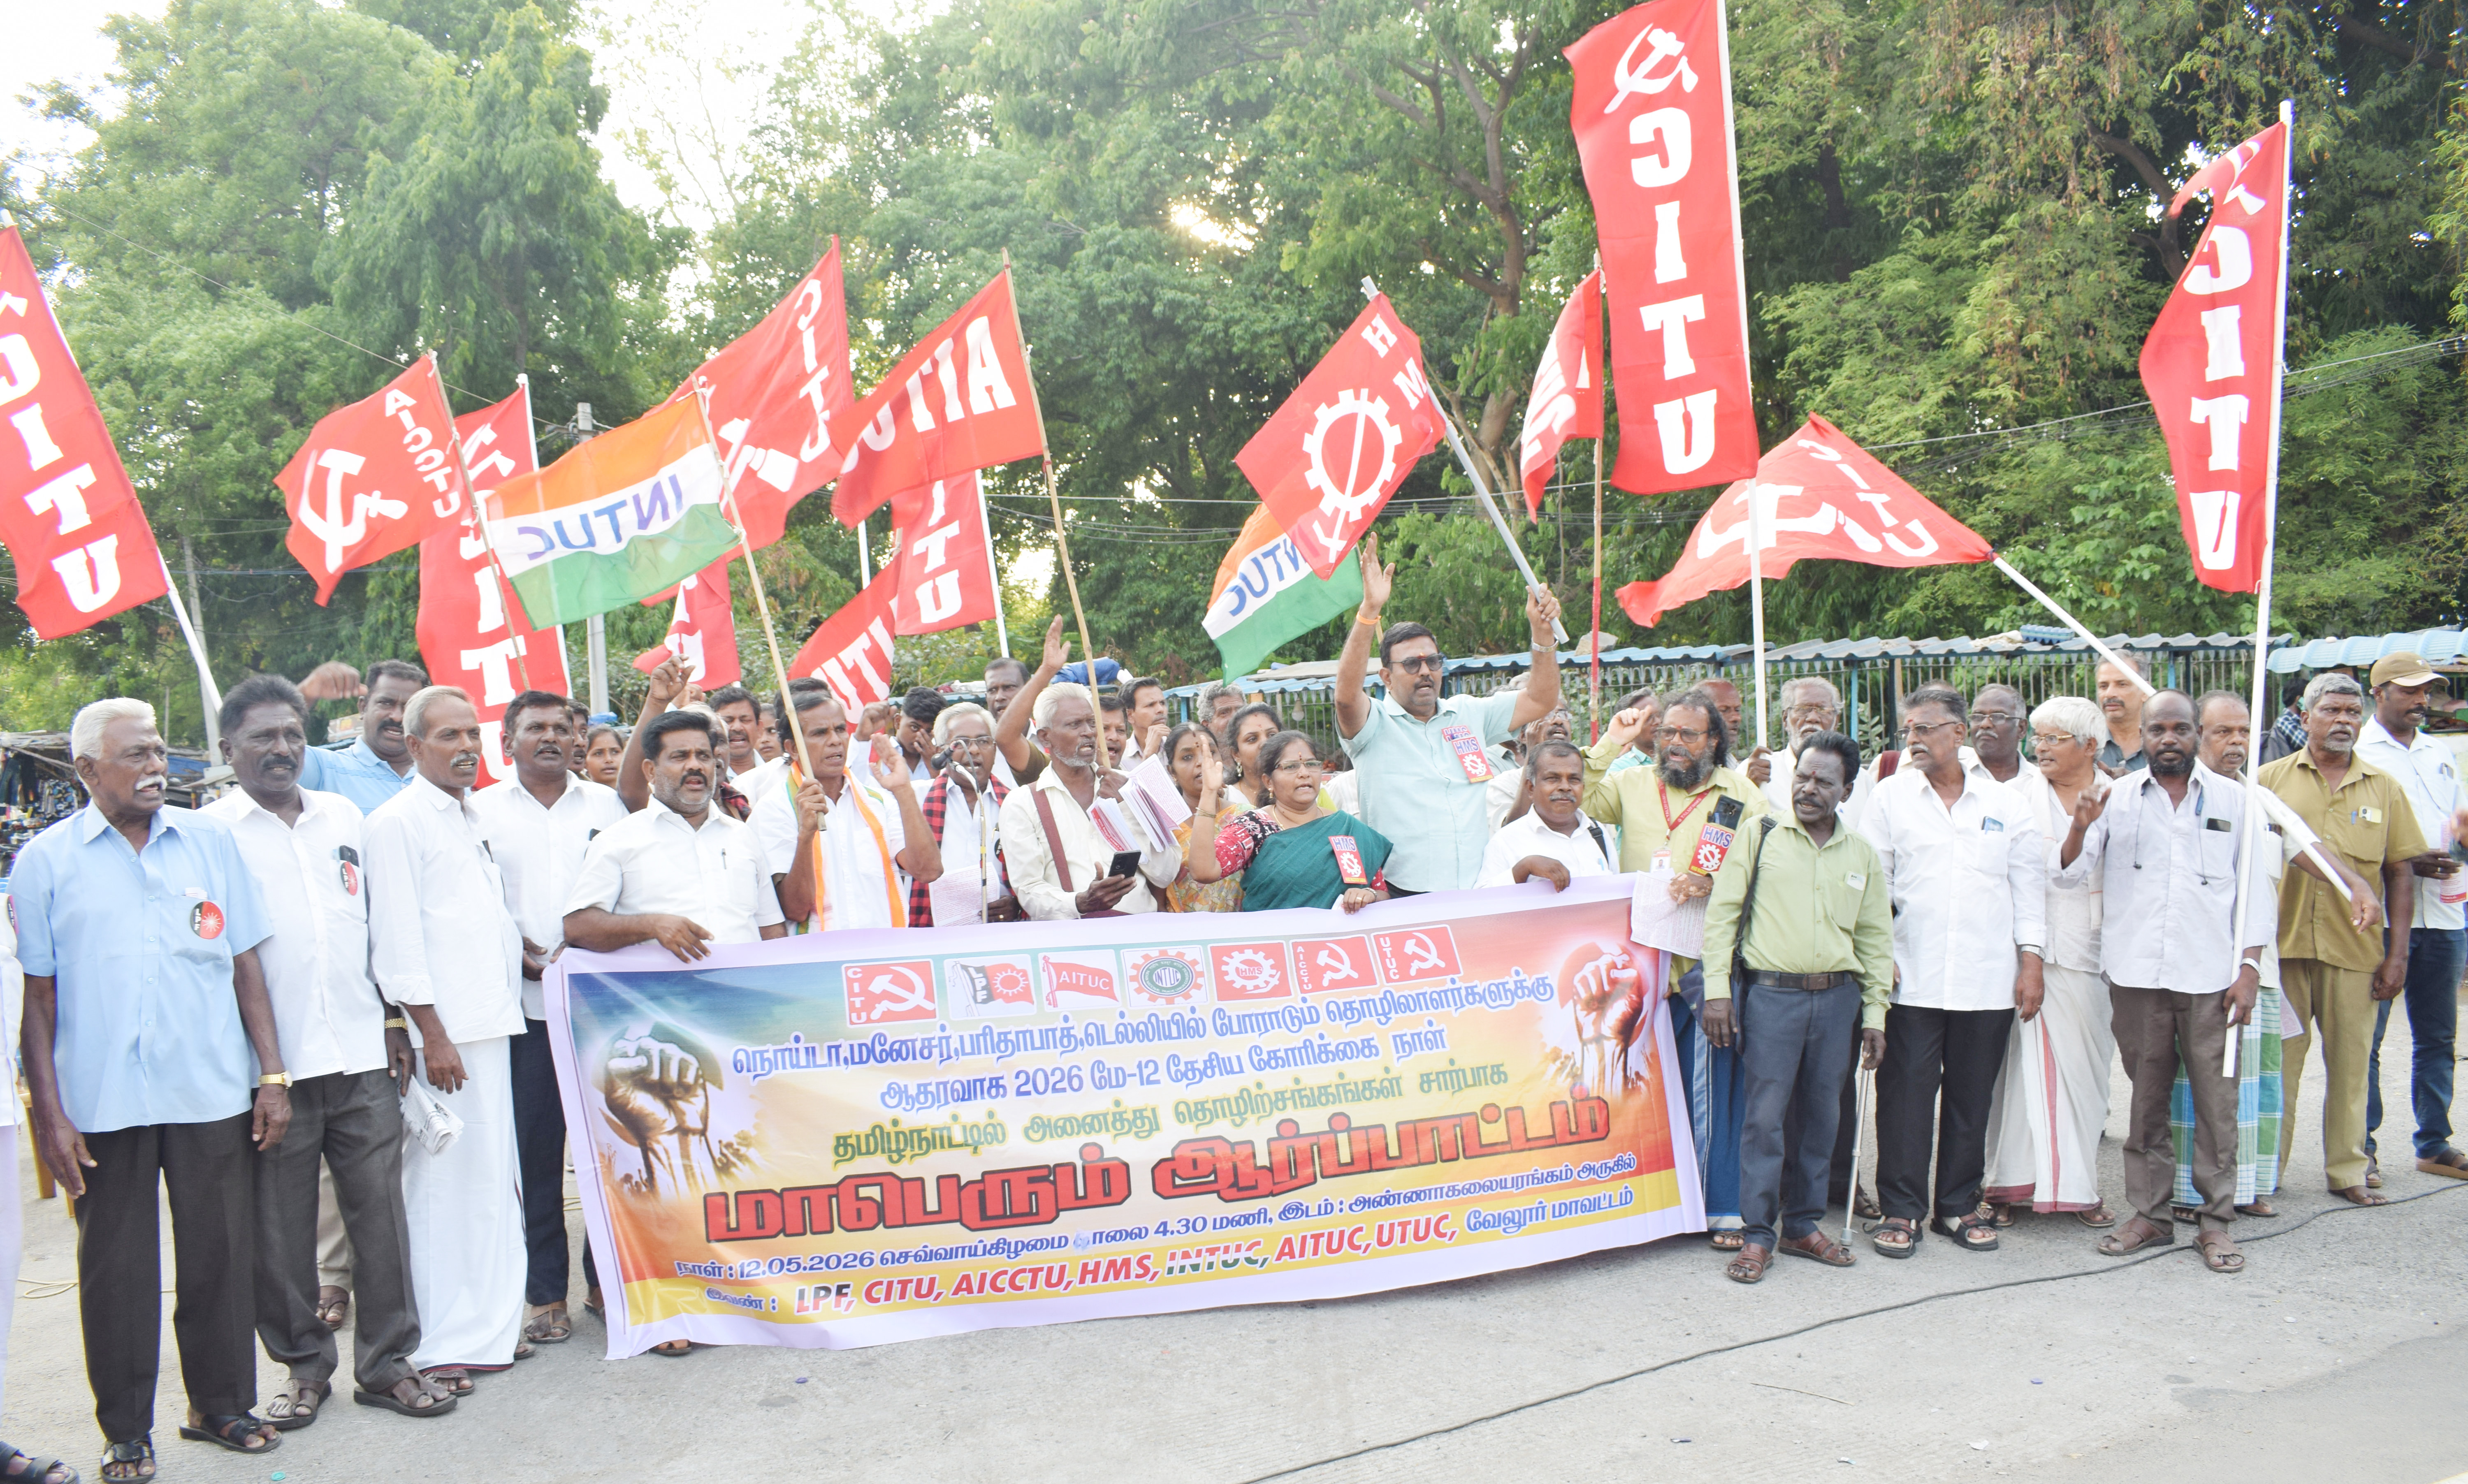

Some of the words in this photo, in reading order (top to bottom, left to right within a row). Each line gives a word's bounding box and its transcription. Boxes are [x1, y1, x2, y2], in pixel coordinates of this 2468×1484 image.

[913, 480, 962, 624] ITU
[1454, 739, 1479, 754] HMS
[1332, 837, 1357, 851] HMS
[1703, 825, 1733, 847] HMS
[1059, 971, 1110, 990] AITUC
[1155, 967, 1180, 986] INTUC
[1239, 966, 1263, 976] HMS
[1297, 946, 1311, 990] AICCTU
[1380, 937, 1400, 980] UTUC
[847, 967, 868, 1024] CITU
[968, 967, 987, 1003] LPF
[1213, 996, 1320, 1038] போராடும்
[1326, 967, 1554, 1029] தொழிலாளர்களுக்கு
[880, 1074, 1007, 1114] ஆதரவாக
[1015, 1064, 1083, 1097] 2026
[1090, 1059, 1161, 1091] மே-12
[1166, 1052, 1245, 1091] தேசிய
[1249, 1033, 1379, 1071] கோரிக்கை
[1392, 1019, 1447, 1062] நாள்
[834, 1111, 1006, 1168] தமிழ்நாட்டில்
[1023, 1099, 1160, 1143] அனைத்து
[1174, 1068, 1403, 1133] தொழிற்சங்கங்கள்
[1420, 1059, 1508, 1096] சார்பாக
[704, 1142, 1132, 1243] மாபெரும்
[1151, 1082, 1610, 1204] ஆர்ப்பாட்டம்
[676, 1261, 723, 1278] நாள்
[739, 1251, 874, 1278] 12.05.2026
[879, 1233, 1069, 1265] செவ்வாய்கிழமை
[1073, 1227, 1149, 1249] ாலை
[1154, 1214, 1207, 1235] 4.30
[1212, 1208, 1273, 1231] மணி,
[1278, 1198, 1334, 1221] இடம்
[1348, 1164, 1573, 1214] அண்ணாகலையரங்கம்
[1576, 1153, 1636, 1179] அருகில்
[797, 1283, 854, 1313] LPF,
[865, 1276, 944, 1302] CITU,
[1167, 1241, 1269, 1275] INTUC,
[1466, 1202, 1548, 1235] வேலூர்
[1552, 1185, 1633, 1219] மாவட்டம்
